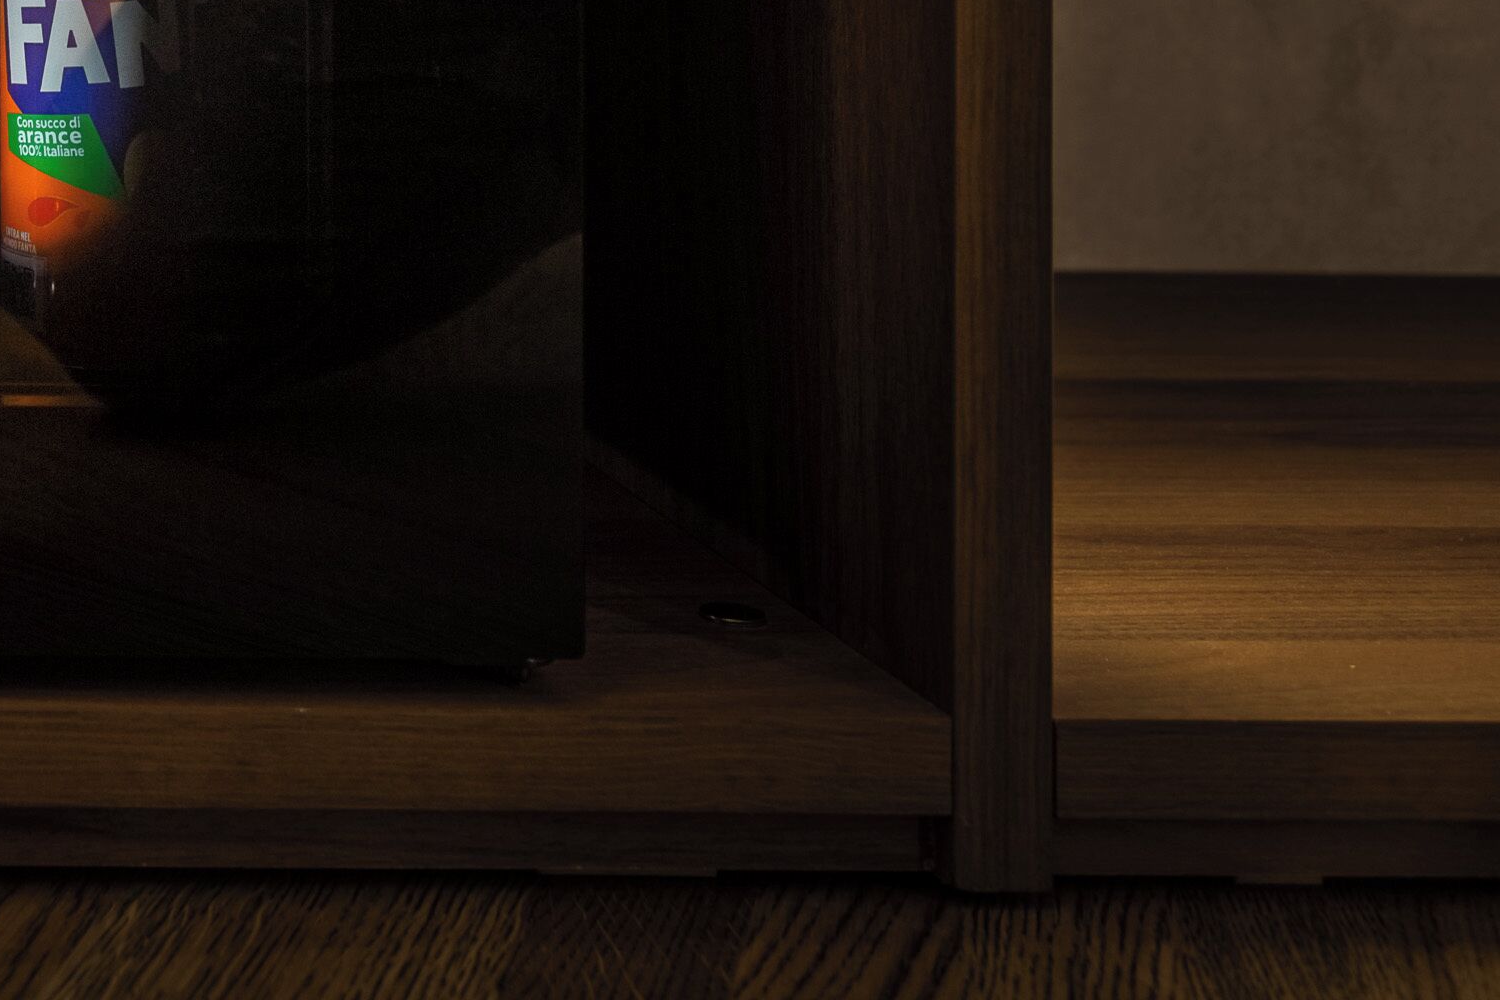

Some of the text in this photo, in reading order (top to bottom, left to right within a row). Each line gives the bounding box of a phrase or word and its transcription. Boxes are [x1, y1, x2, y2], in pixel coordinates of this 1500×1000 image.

[16, 116, 81, 130] Con succo di
[17, 130, 82, 144] arance
[19, 144, 85, 158] 100% Italiane
